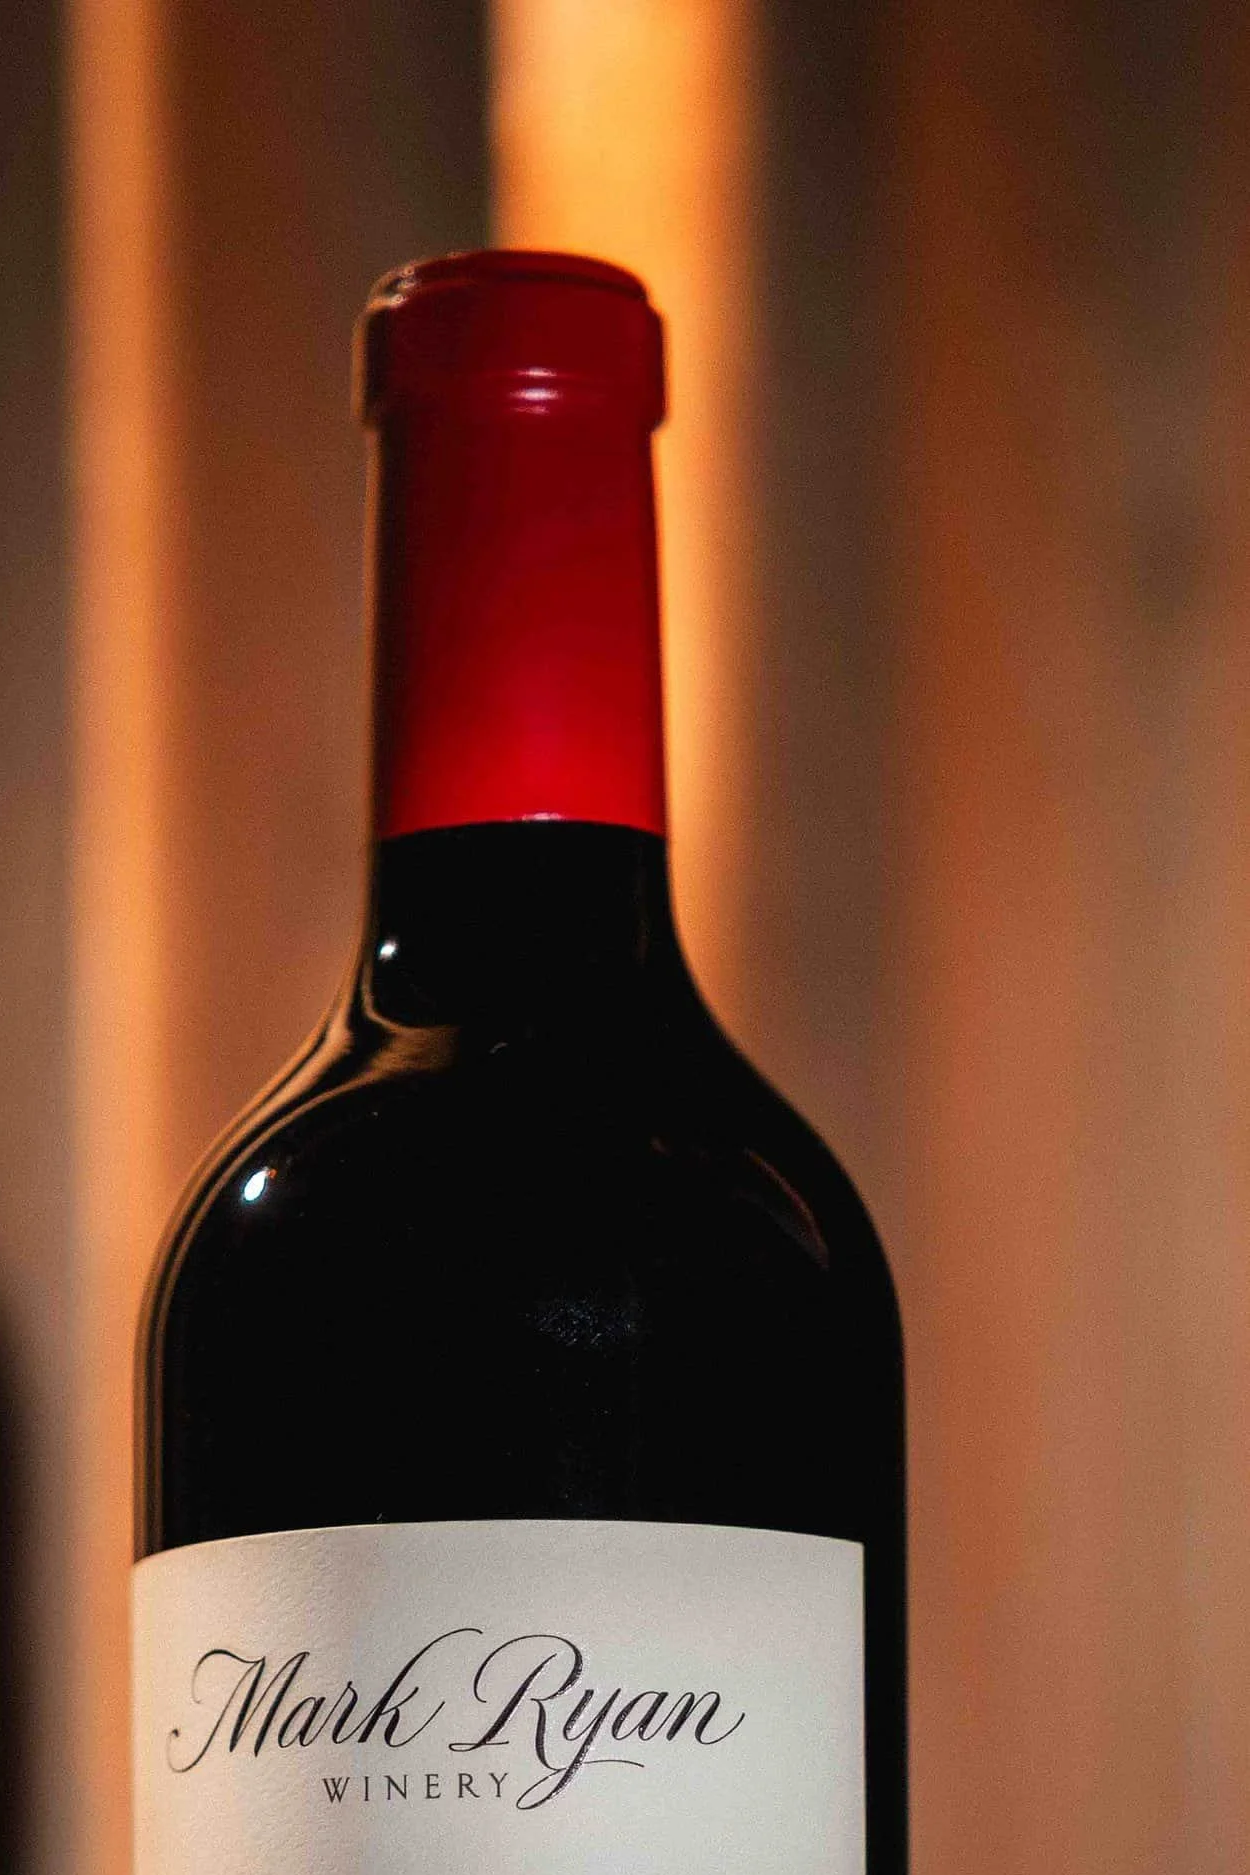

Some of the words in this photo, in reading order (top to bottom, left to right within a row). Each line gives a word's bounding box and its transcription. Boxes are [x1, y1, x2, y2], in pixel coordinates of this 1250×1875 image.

[167, 1628, 484, 1774] Mark
[449, 1633, 747, 1811] Ryan
[322, 1771, 509, 1804] WINERY
